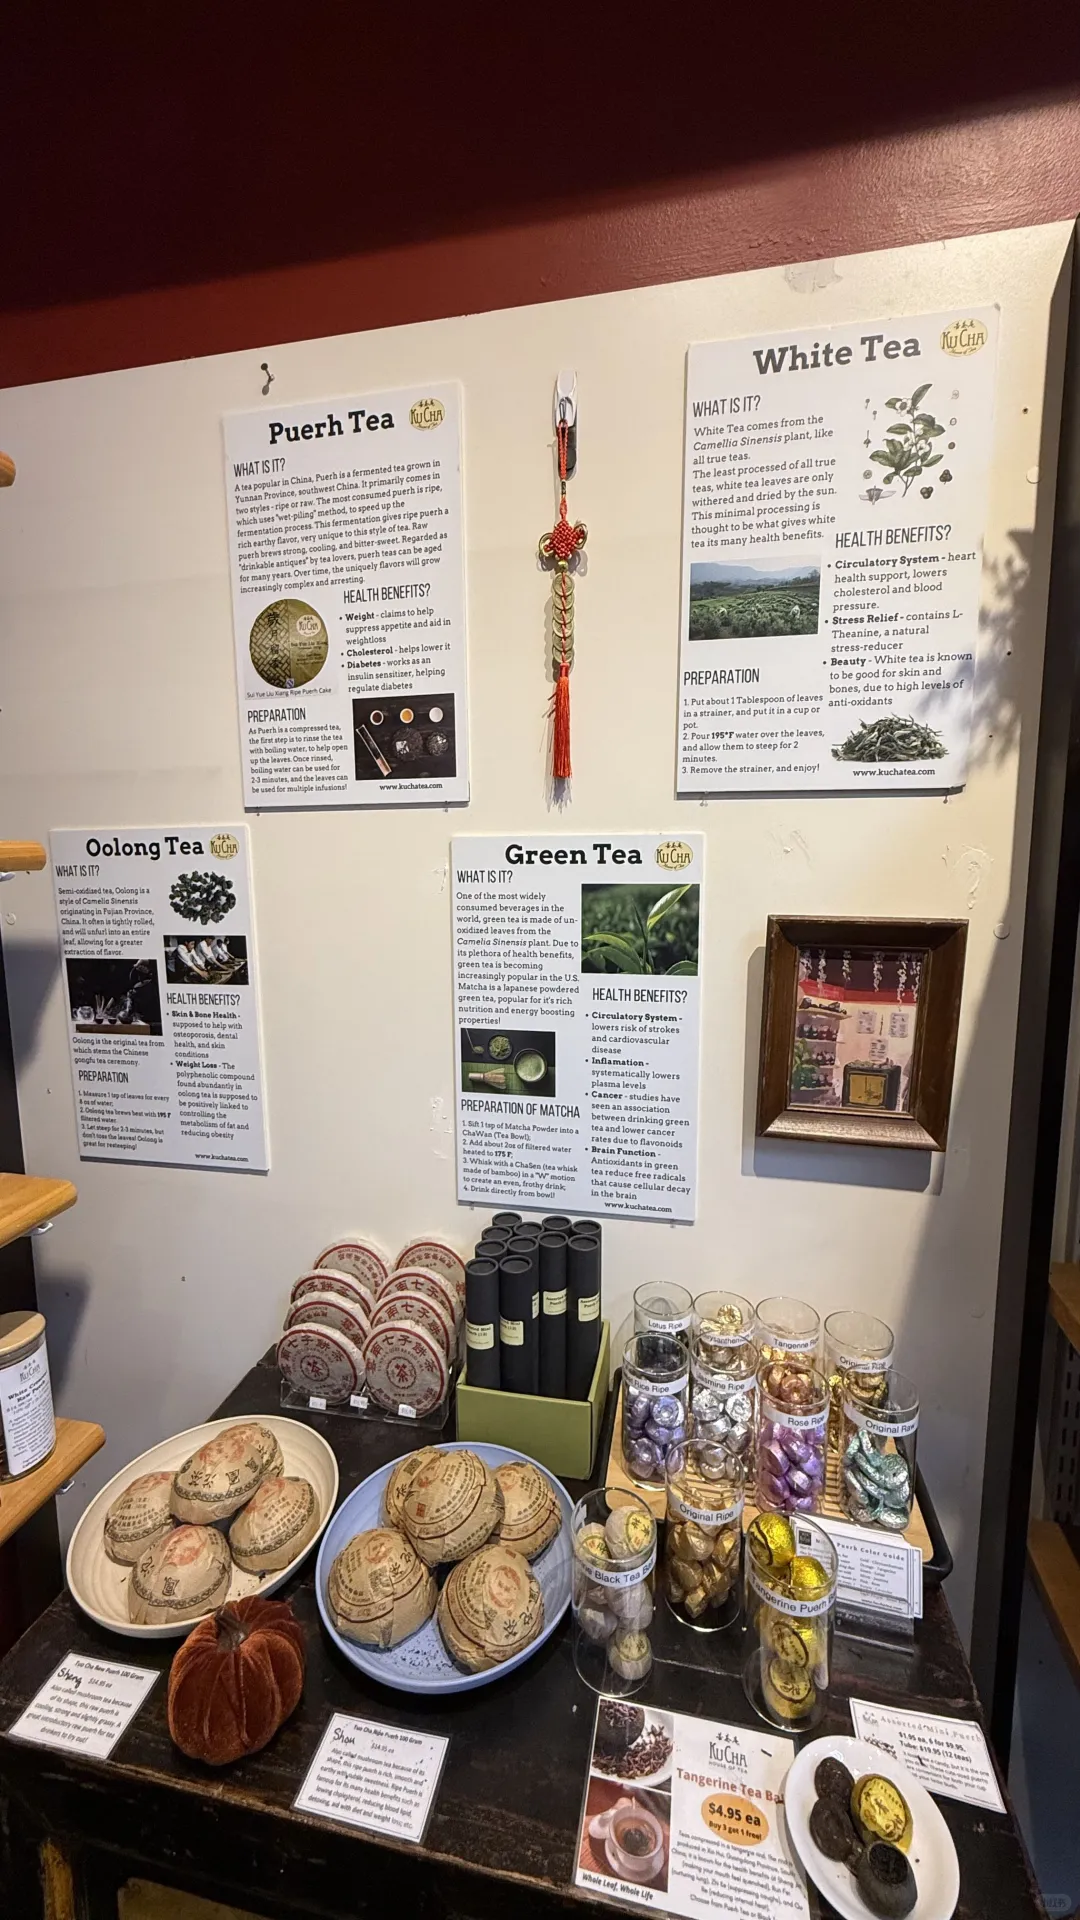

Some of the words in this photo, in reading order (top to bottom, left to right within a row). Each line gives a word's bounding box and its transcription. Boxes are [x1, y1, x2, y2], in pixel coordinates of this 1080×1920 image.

[752, 341, 852, 375] White
[860, 334, 920, 362] Tea
[692, 398, 727, 417] WHAT
[729, 396, 740, 413] IS
[742, 394, 760, 412] IT?
[268, 413, 343, 445] Puerh
[347, 409, 394, 433] Tea
[693, 425, 724, 436] White
[726, 423, 744, 433] Tea
[746, 420, 778, 431] comes
[780, 417, 805, 427] from
[807, 414, 823, 424] the
[692, 438, 738, 451] Camellia
[739, 432, 782, 446] Sinensis
[783, 430, 812, 444] plant,
[814, 428, 833, 438] like
[233, 460, 260, 477] WHAT
[261, 459, 270, 474] IS
[271, 457, 285, 472] IT?
[234, 483, 240, 492] A
[240, 483, 252, 491] tea
[252, 478, 280, 491] popular
[281, 477, 289, 486] in
[290, 475, 314, 484] China,
[315, 471, 337, 482] Puerh
[338, 470, 345, 479] is
[352, 464, 392, 477] fermented
[392, 464, 405, 472] tea
[406, 461, 431, 472] grown
[432, 458, 440, 467] in
[835, 529, 882, 548] HEALTH
[885, 523, 951, 544] BENEFITS?
[833, 572, 866, 583] health
[868, 570, 910, 582] support,
[912, 568, 947, 578] lowers
[343, 587, 379, 604] HEALTH
[380, 583, 430, 600] BENEFITS?
[683, 667, 759, 686] PREPARATION
[247, 707, 306, 723] PREPARATION
[682, 732, 689, 740] 2.
[690, 732, 710, 740] Pour
[780, 729, 794, 737] the
[795, 728, 824, 737] leaves,
[852, 767, 935, 776] www.kuchatea.com
[378, 782, 443, 790] www.kuchatea.com
[85, 837, 160, 860] Oolong
[163, 836, 204, 855] Tea
[504, 843, 587, 864] Green
[592, 843, 642, 864] Tea
[55, 864, 78, 877] WHAT
[79, 864, 87, 877] IS
[87, 864, 99, 876] IT?
[456, 870, 485, 883] WHAT
[487, 870, 496, 883] IS
[498, 870, 513, 883] IT?
[455, 891, 472, 899] One
[473, 891, 482, 899] of
[482, 891, 496, 899] the
[519, 892, 546, 902] widely
[166, 992, 197, 1004] HEALTH
[198, 992, 240, 1006] BENEFITS?
[592, 987, 631, 1001] HEALTH
[633, 988, 687, 1003] BENEFITS?
[591, 1022, 619, 1031] lowers
[620, 1023, 637, 1032] risk
[638, 1024, 647, 1032] of
[648, 1025, 679, 1033] strokes
[71, 1036, 95, 1045] Oolong
[101, 1037, 112, 1045] the
[112, 1038, 137, 1047] original
[148, 1039, 165, 1047] from
[78, 1070, 128, 1083] PREPARATION
[460, 1099, 523, 1114] PREPARATION
[525, 1102, 537, 1115] OF
[539, 1103, 580, 1118] MATCHA
[194, 1153, 248, 1162] www.kuchatea.com
[603, 1201, 672, 1212] www.kuchatea.com
[648, 1320, 667, 1329] Lotus
[668, 1321, 683, 1330] Ripe
[634, 1380, 649, 1391] Rice
[788, 1417, 809, 1426] Rose
[812, 1415, 825, 1425] Ripe
[865, 1419, 899, 1434] Original
[901, 1422, 915, 1433] Raw
[679, 1503, 714, 1522] Original
[715, 1510, 734, 1522] Ripe
[595, 1570, 620, 1583] Black
[624, 1572, 640, 1582] Tea
[751, 1574, 796, 1612] Tangerine
[800, 1600, 826, 1613] Puerh
[676, 1767, 737, 1792] Tangerine
[739, 1782, 762, 1799] Tea
[708, 1802, 741, 1821] $4.95
[744, 1814, 760, 1826] ea
[708, 1820, 721, 1831] Buy
[727, 1826, 739, 1834] get
[745, 1829, 761, 1840] free!
[582, 1872, 602, 1886] Whole
[619, 1883, 640, 1896] Whole
[640, 1889, 653, 1901] Life
